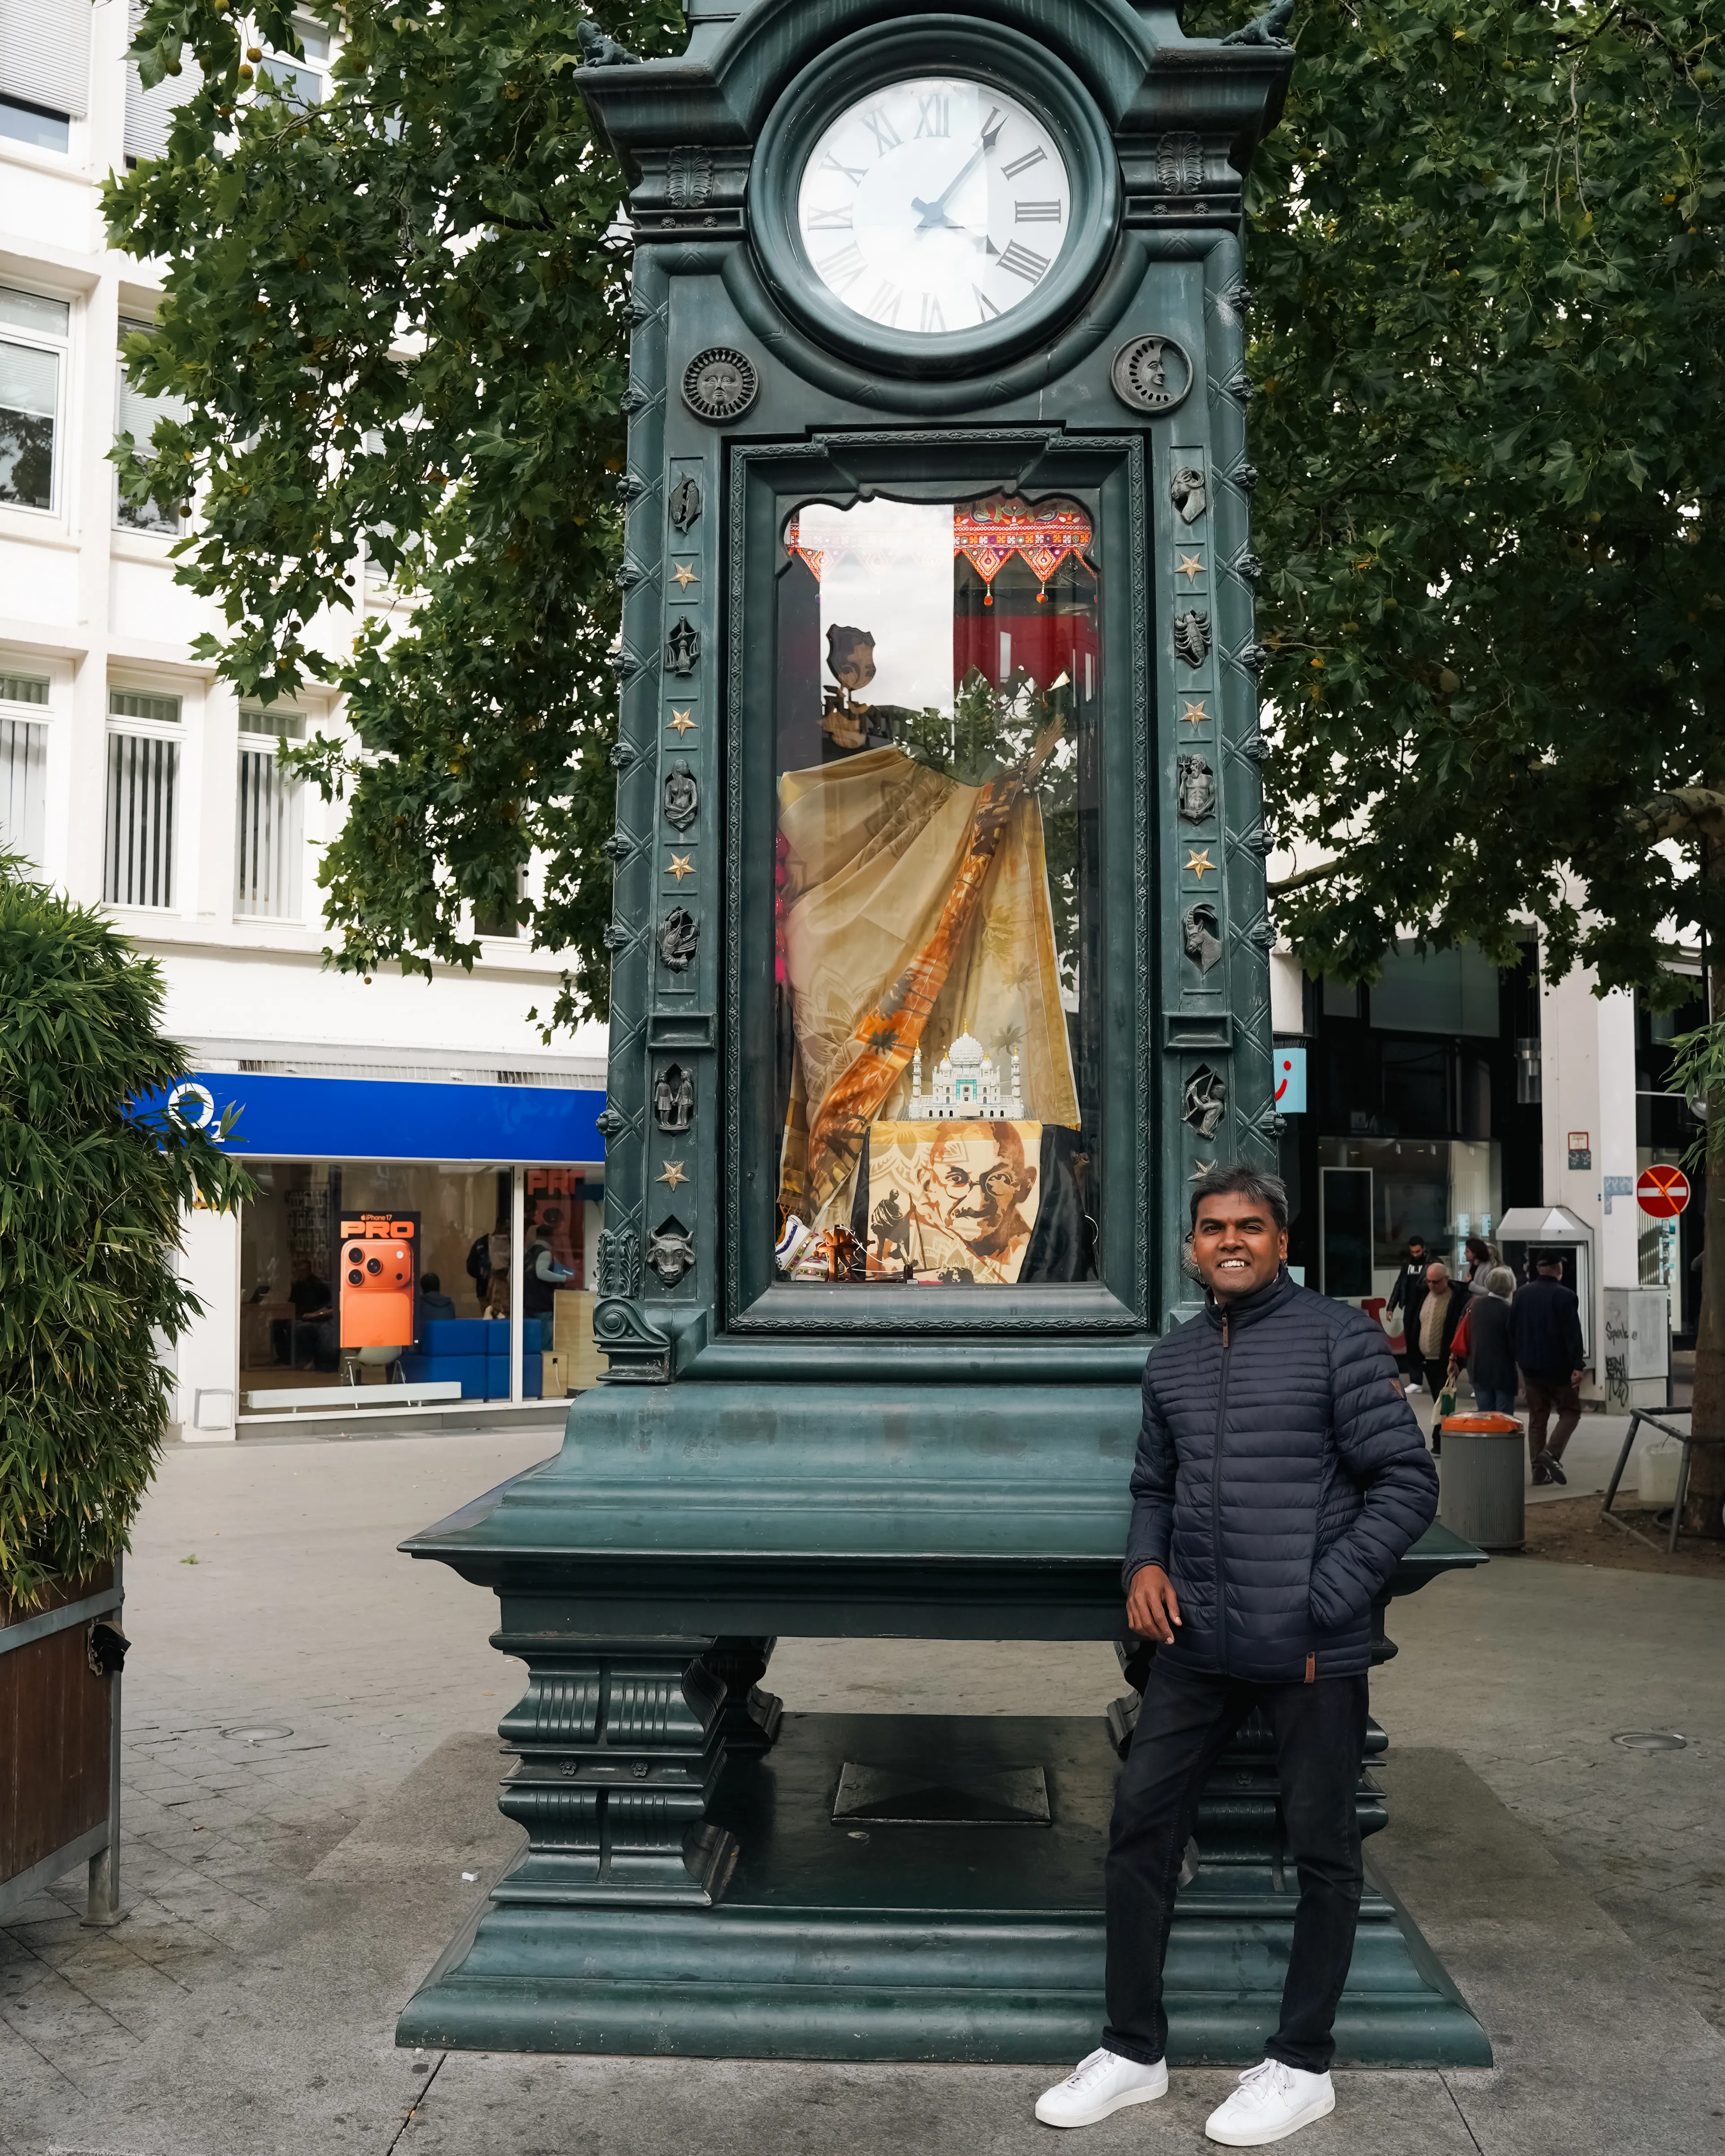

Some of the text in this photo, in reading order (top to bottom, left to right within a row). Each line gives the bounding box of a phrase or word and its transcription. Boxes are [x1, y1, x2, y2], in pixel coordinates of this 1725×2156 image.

[858, 107, 905, 158] XI
[913, 95, 951, 140] XII
[820, 151, 869, 188] X
[1001, 145, 1048, 181] II
[808, 202, 853, 232] IX
[1014, 199, 1061, 223] III
[972, 283, 1001, 322] V
[341, 1221, 414, 1238] PRO
